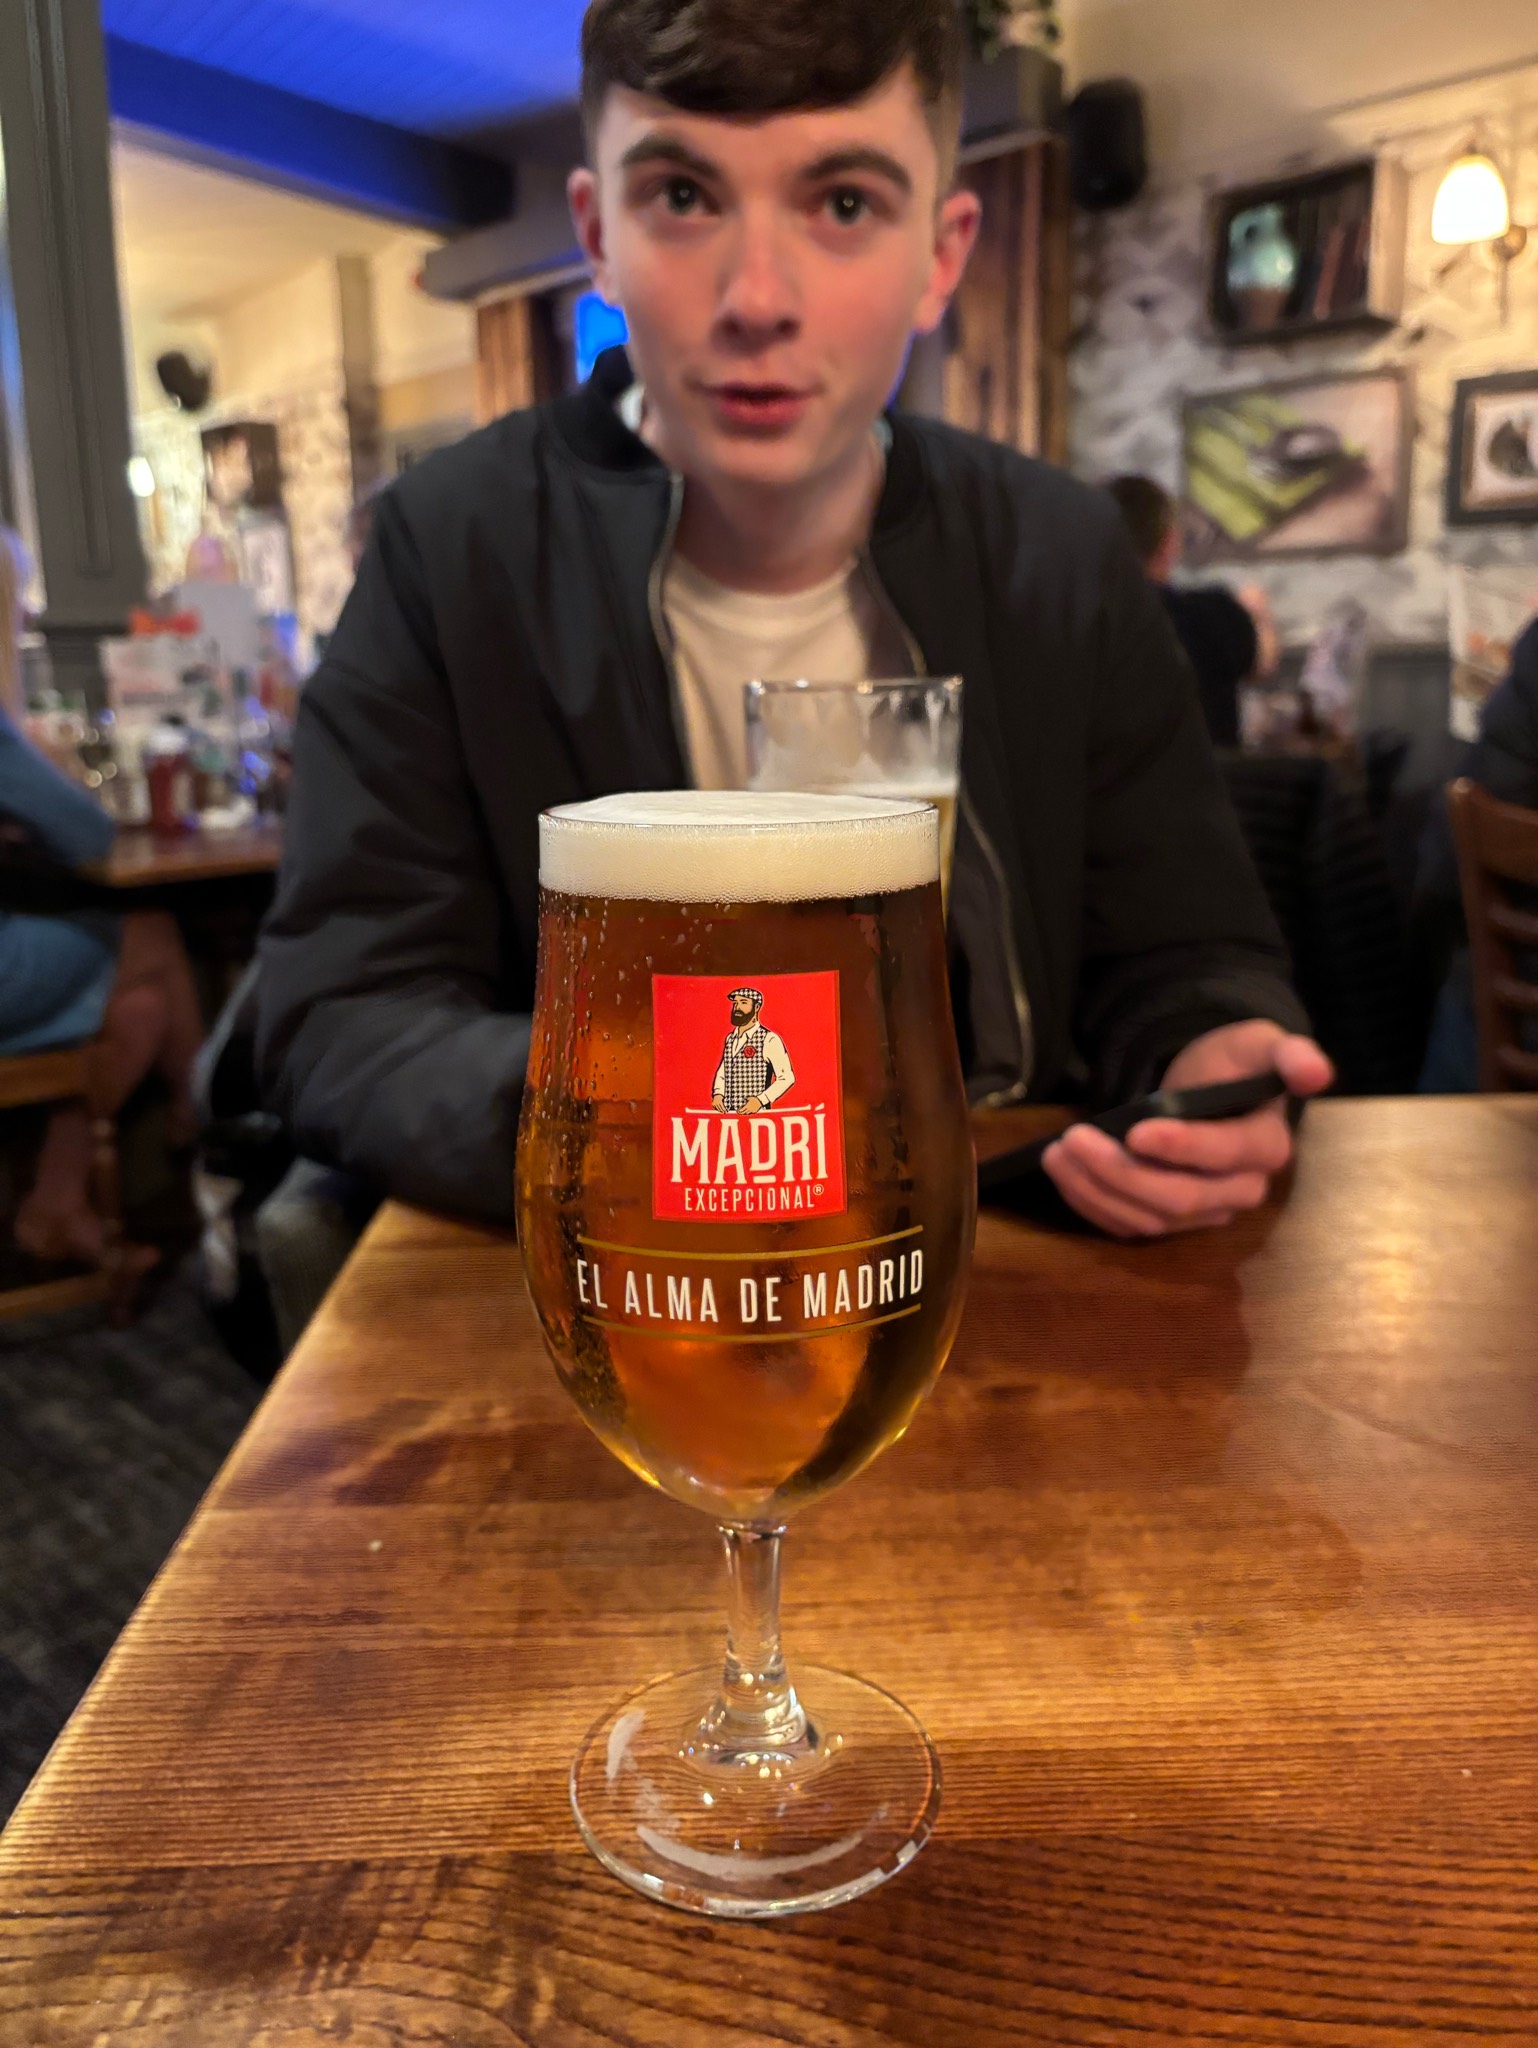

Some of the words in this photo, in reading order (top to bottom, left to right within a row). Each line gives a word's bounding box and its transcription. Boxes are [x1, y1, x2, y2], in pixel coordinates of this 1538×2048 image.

[670, 1103, 829, 1185] MADRÍ
[577, 1258, 608, 1309] EL
[625, 1270, 719, 1323] ALMA
[740, 1276, 782, 1323] DE
[803, 1249, 924, 1319] MADRID
